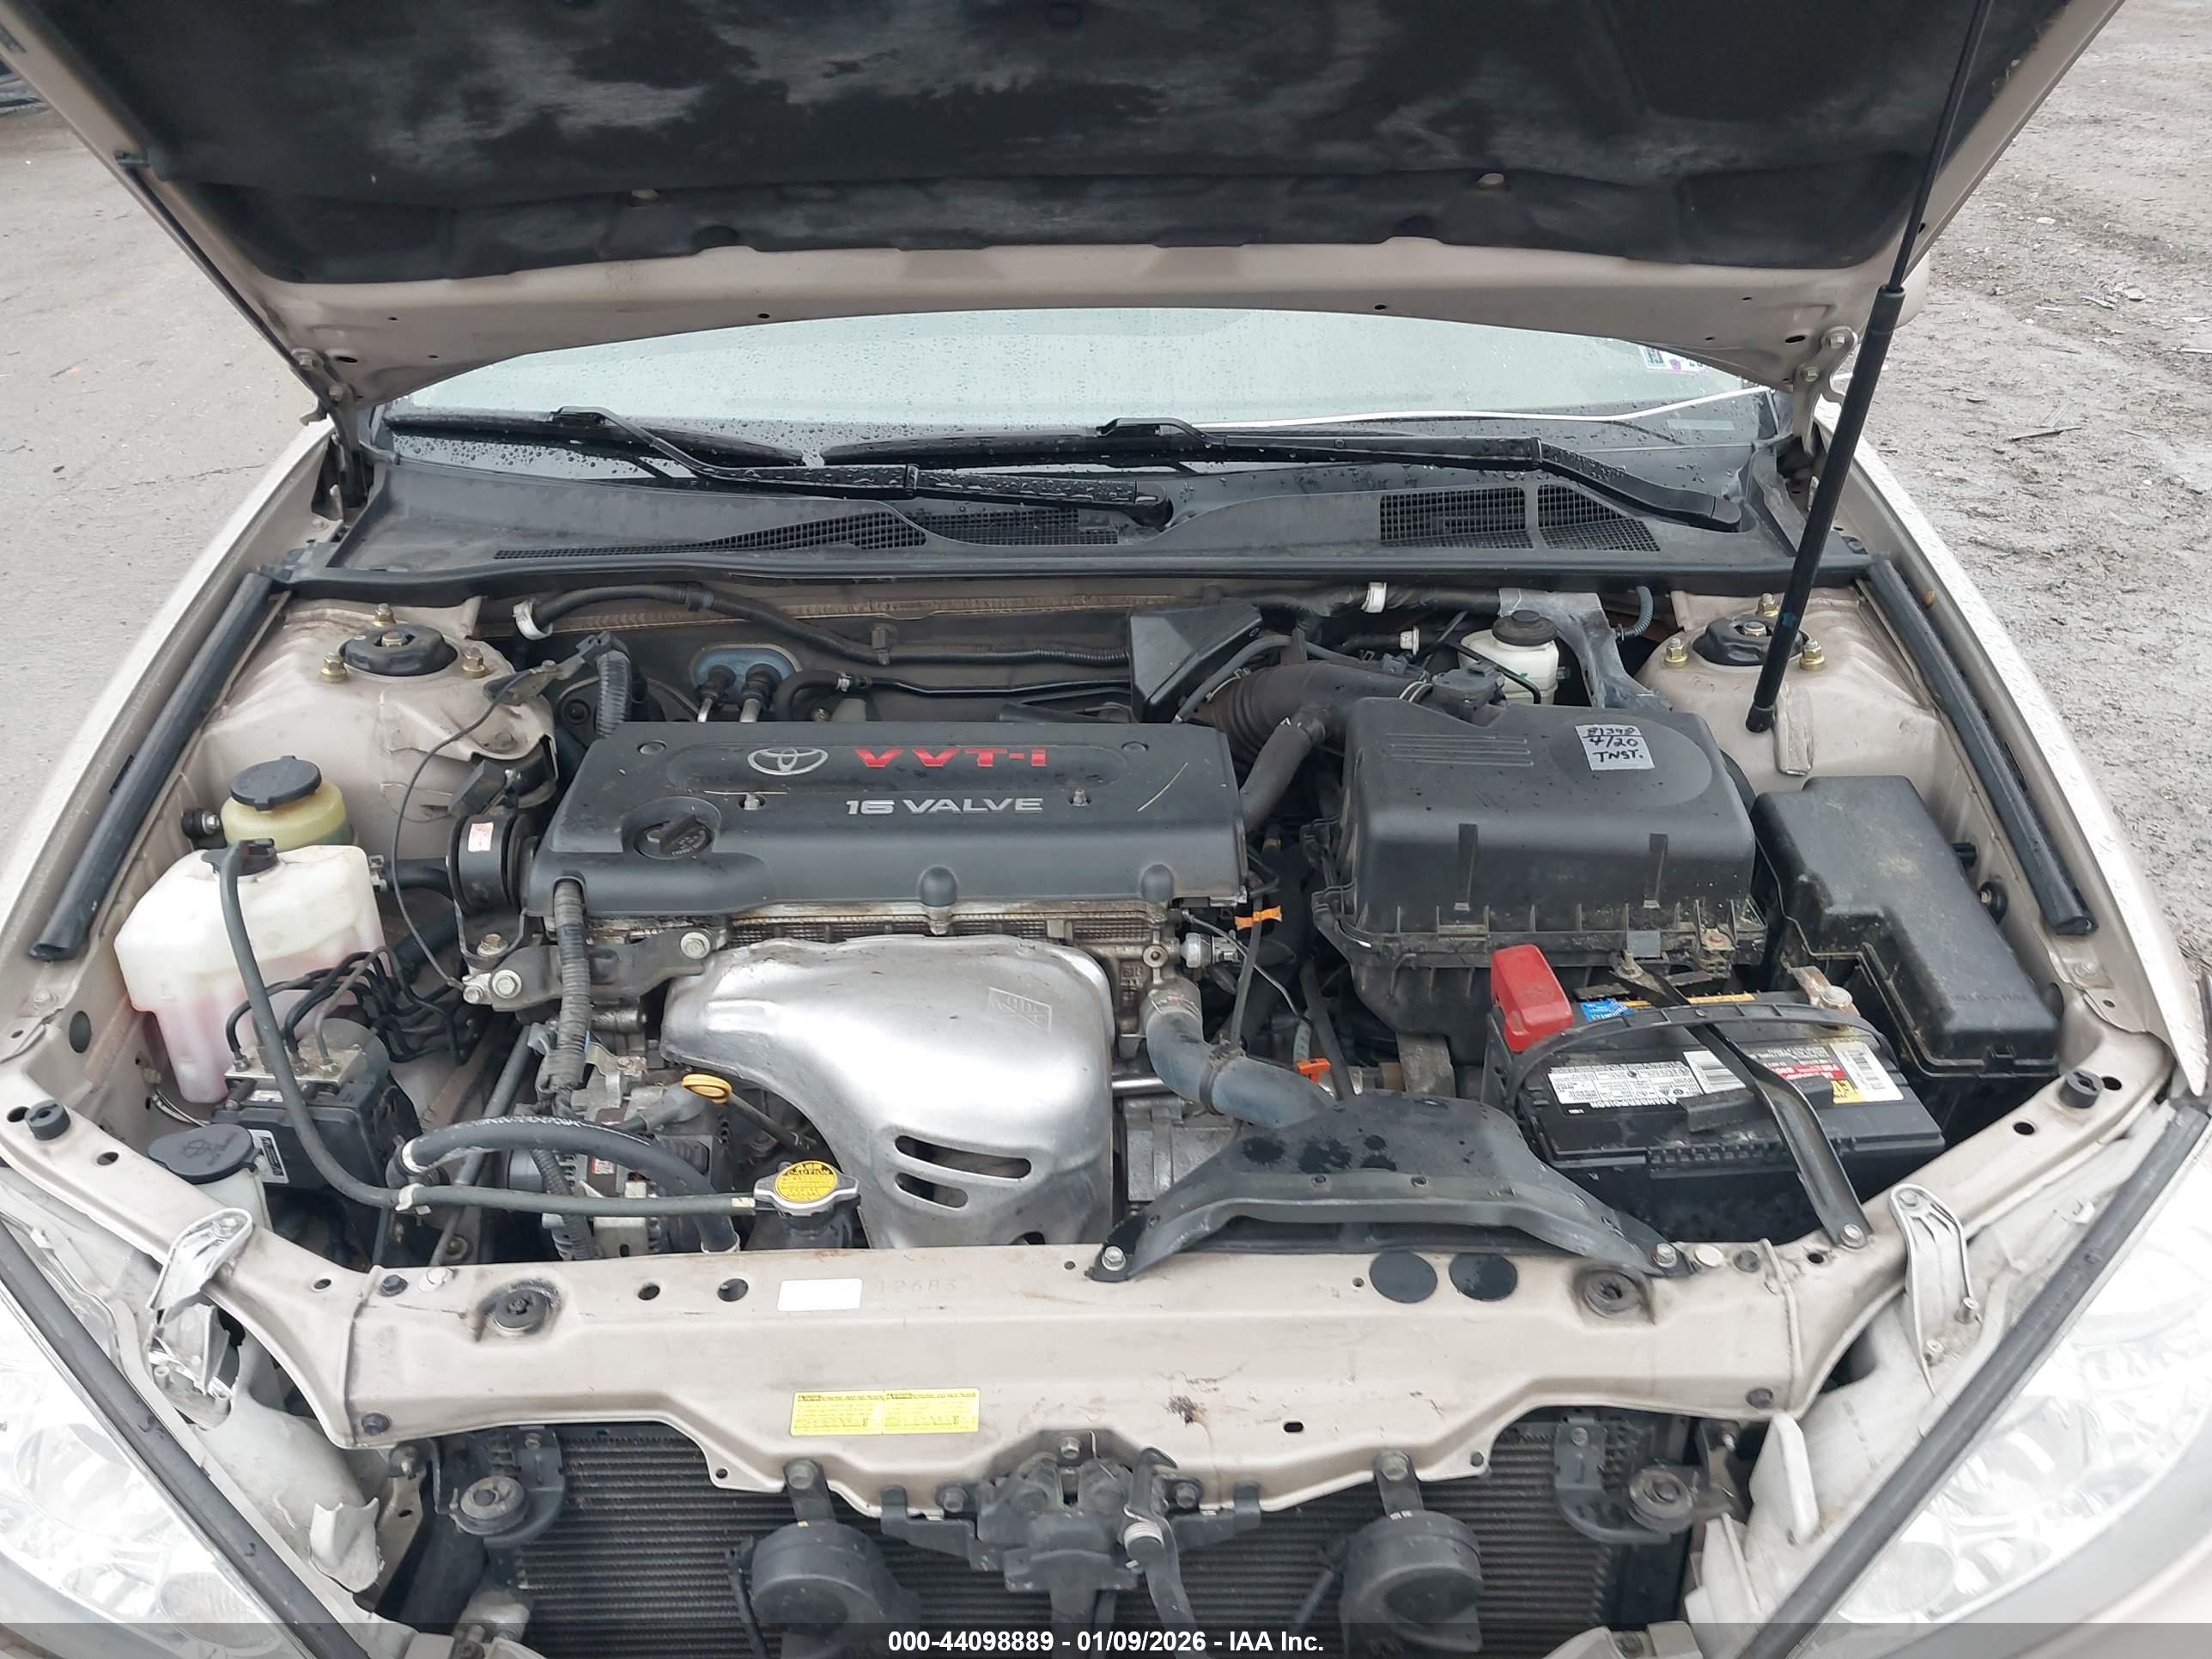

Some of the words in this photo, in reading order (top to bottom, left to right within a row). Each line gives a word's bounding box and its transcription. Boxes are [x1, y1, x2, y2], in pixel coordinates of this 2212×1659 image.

[1589, 736, 1638, 748] 4/20
[846, 798, 895, 815] 16
[902, 797, 1044, 814] VALVE
